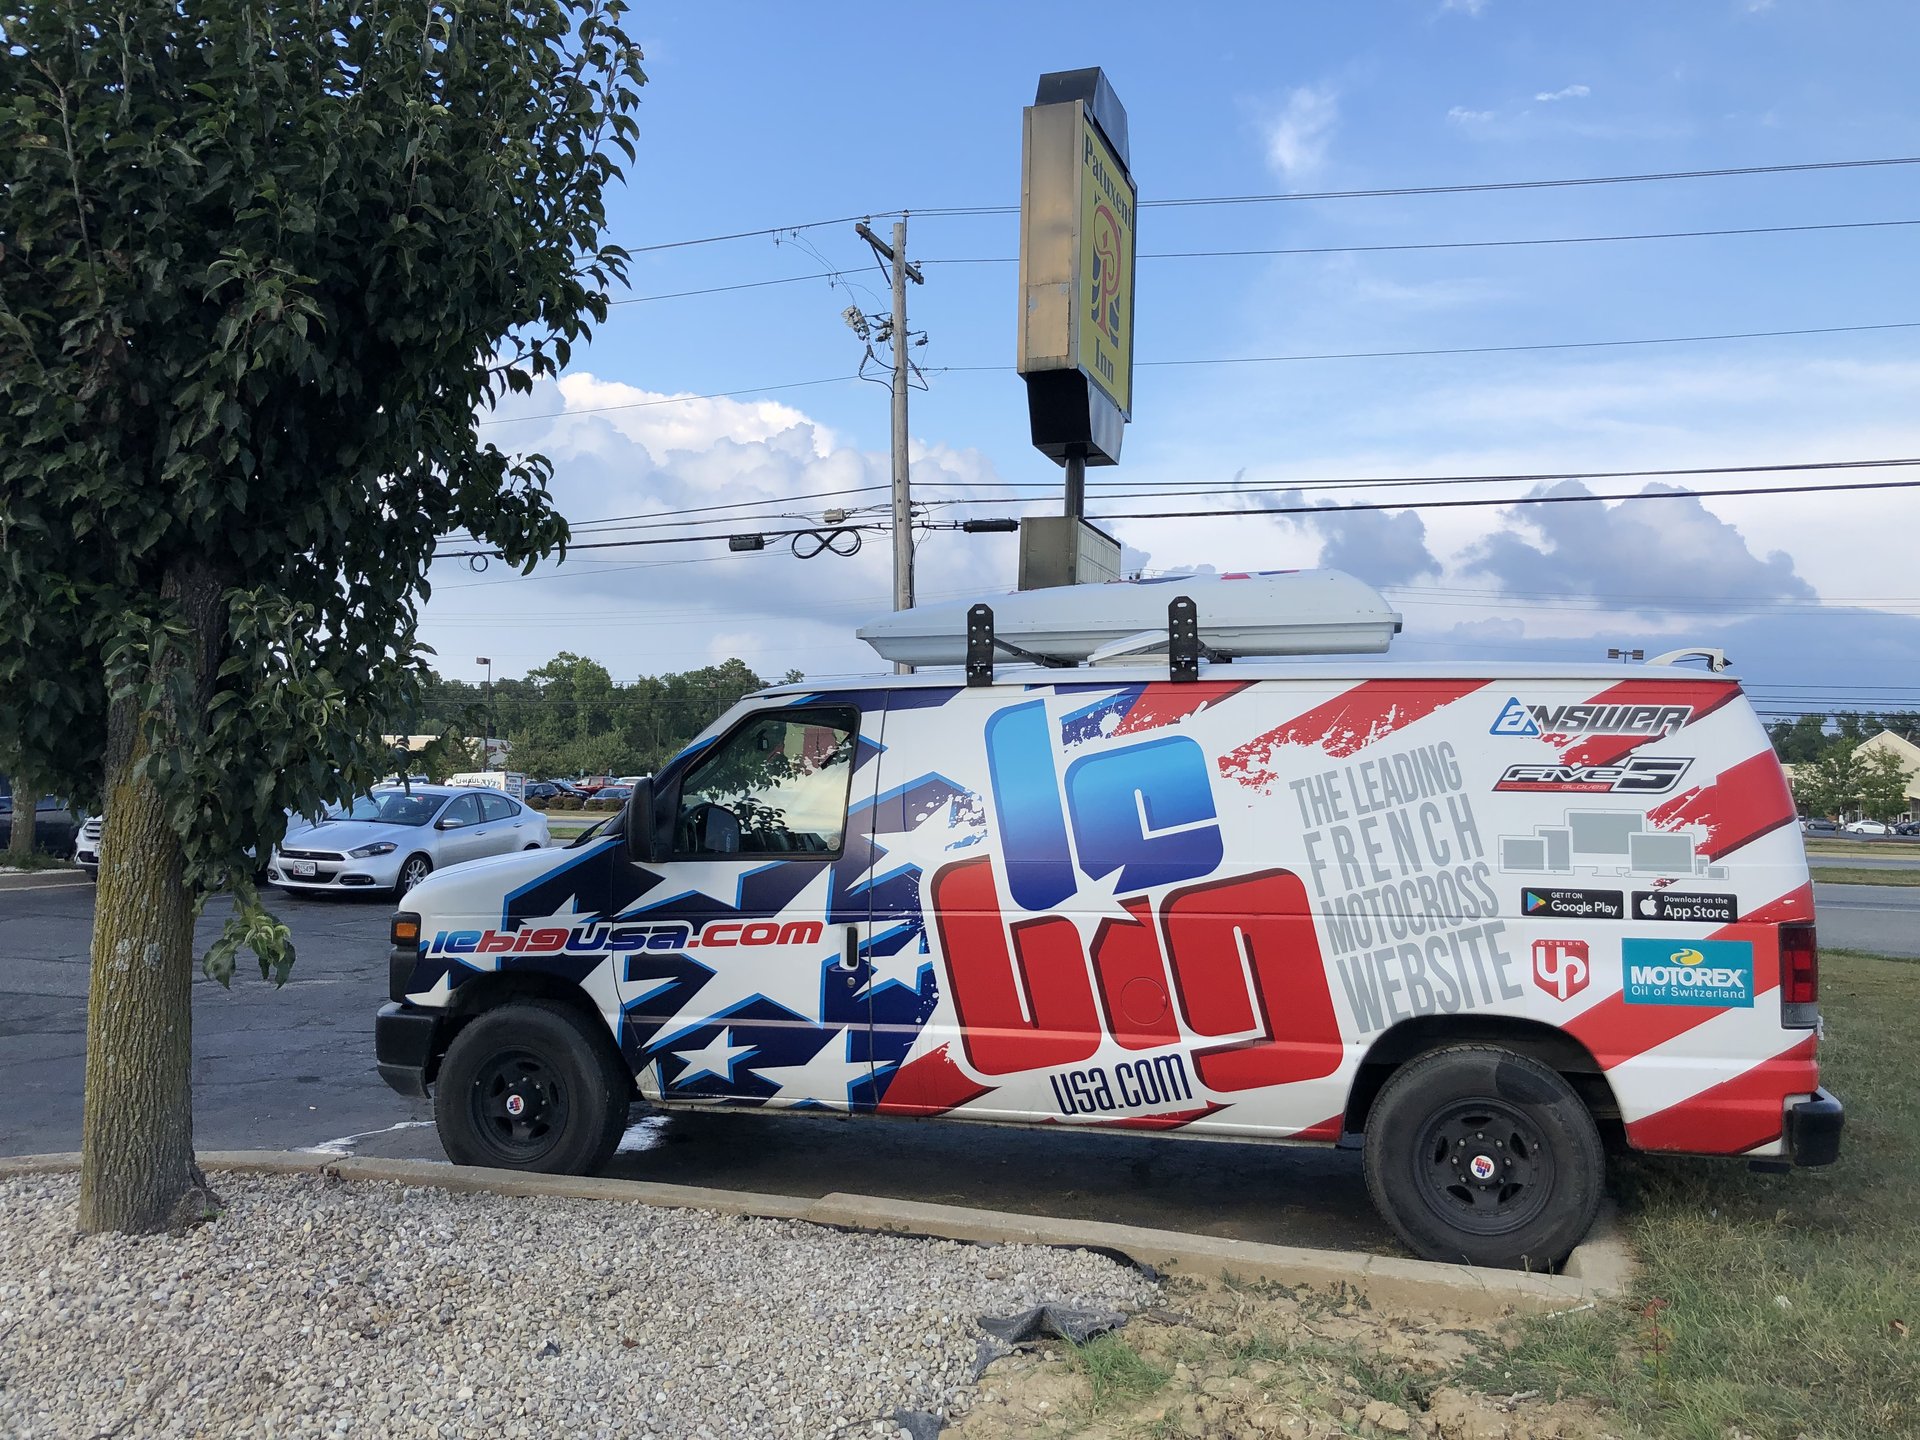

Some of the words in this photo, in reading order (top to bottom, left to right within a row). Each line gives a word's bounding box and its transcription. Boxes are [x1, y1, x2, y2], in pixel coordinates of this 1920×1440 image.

[1084, 132, 1132, 232] Patuxent
[1095, 336, 1114, 385] Inn
[1288, 770, 1349, 829] THE
[1344, 741, 1463, 816] LEADING
[1302, 792, 1485, 898] FRENCH
[1320, 861, 1499, 956] MOTOCROSS
[1551, 900, 1592, 915] Google
[1594, 901, 1618, 916] Play
[1663, 895, 1701, 903] Download
[1663, 904, 1691, 919] App
[1693, 905, 1730, 919] Store
[430, 920, 825, 954] lebigusa.com
[1335, 919, 1524, 1034] WEBSITE
[1630, 965, 1745, 988] MOTOREX
[1631, 985, 1649, 996] Oil
[1653, 986, 1666, 996] of
[1670, 986, 1746, 999] Switzerland
[1050, 1053, 1193, 1116] usa.com
